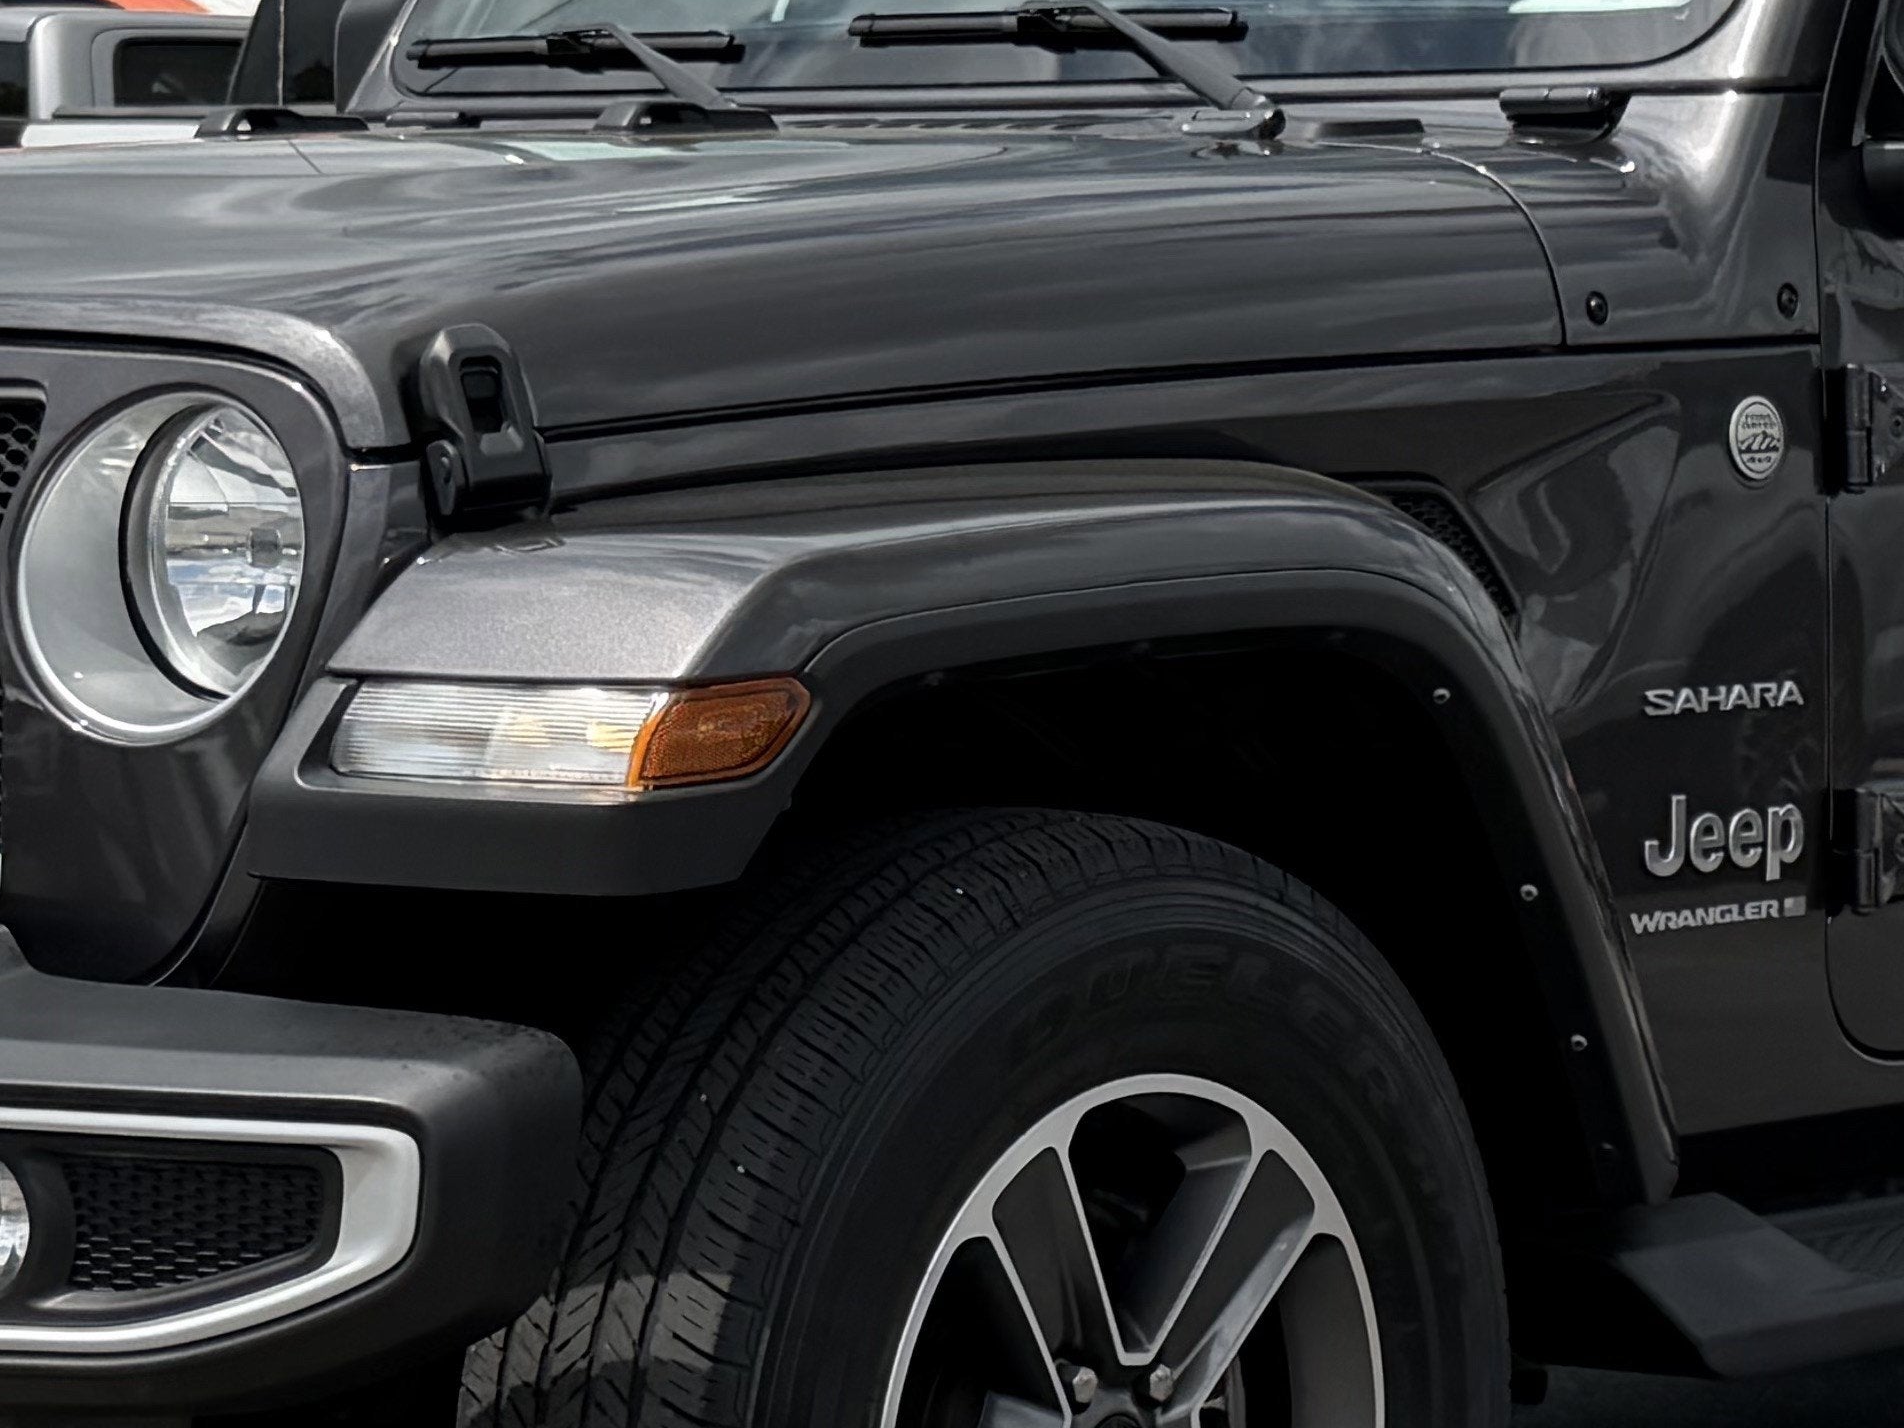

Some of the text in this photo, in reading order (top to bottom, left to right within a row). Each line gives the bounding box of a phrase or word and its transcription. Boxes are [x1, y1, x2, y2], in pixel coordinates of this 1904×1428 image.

[1643, 680, 1805, 717] SAHARA
[1643, 793, 1805, 882] Jeep
[1629, 899, 1780, 935] WRANGLER
